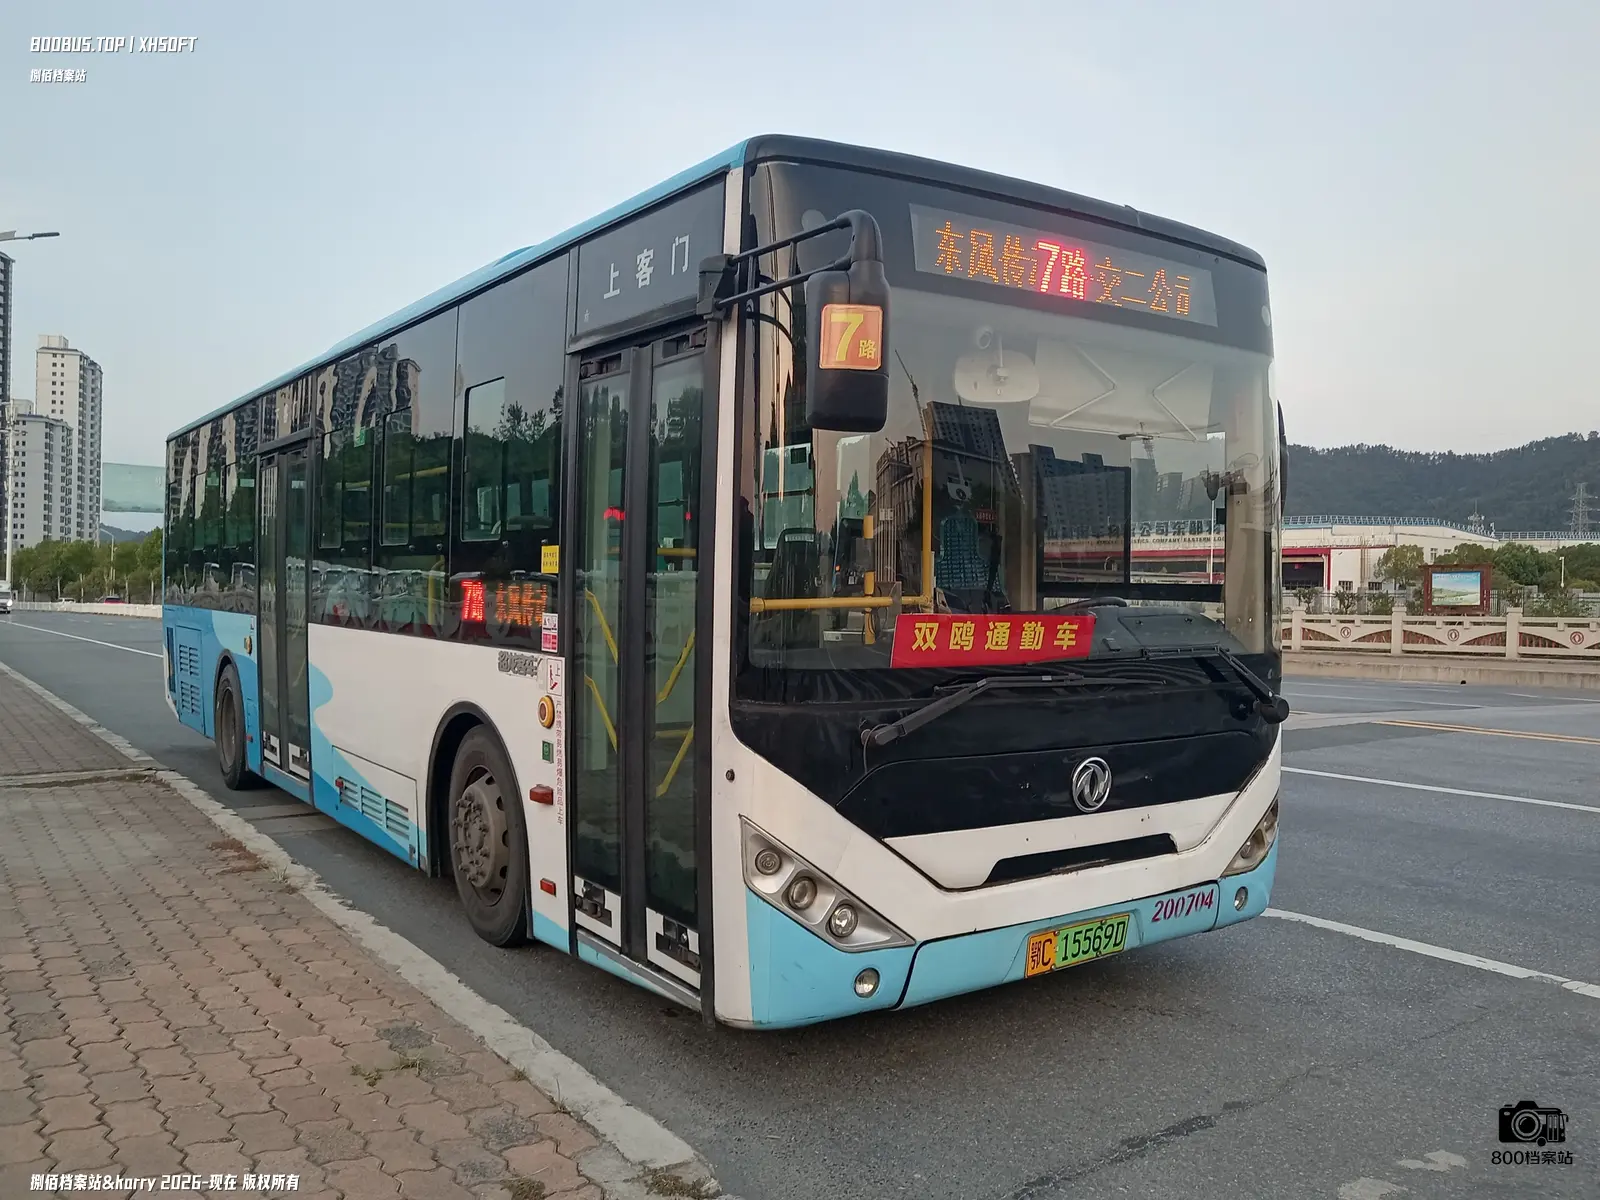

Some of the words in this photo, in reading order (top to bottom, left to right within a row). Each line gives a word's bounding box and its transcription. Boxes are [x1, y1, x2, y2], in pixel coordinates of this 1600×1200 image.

[603, 234, 690, 300] 上客门
[911, 620, 1079, 652] 双鸥通勤车
[1151, 888, 1215, 923] 200704
